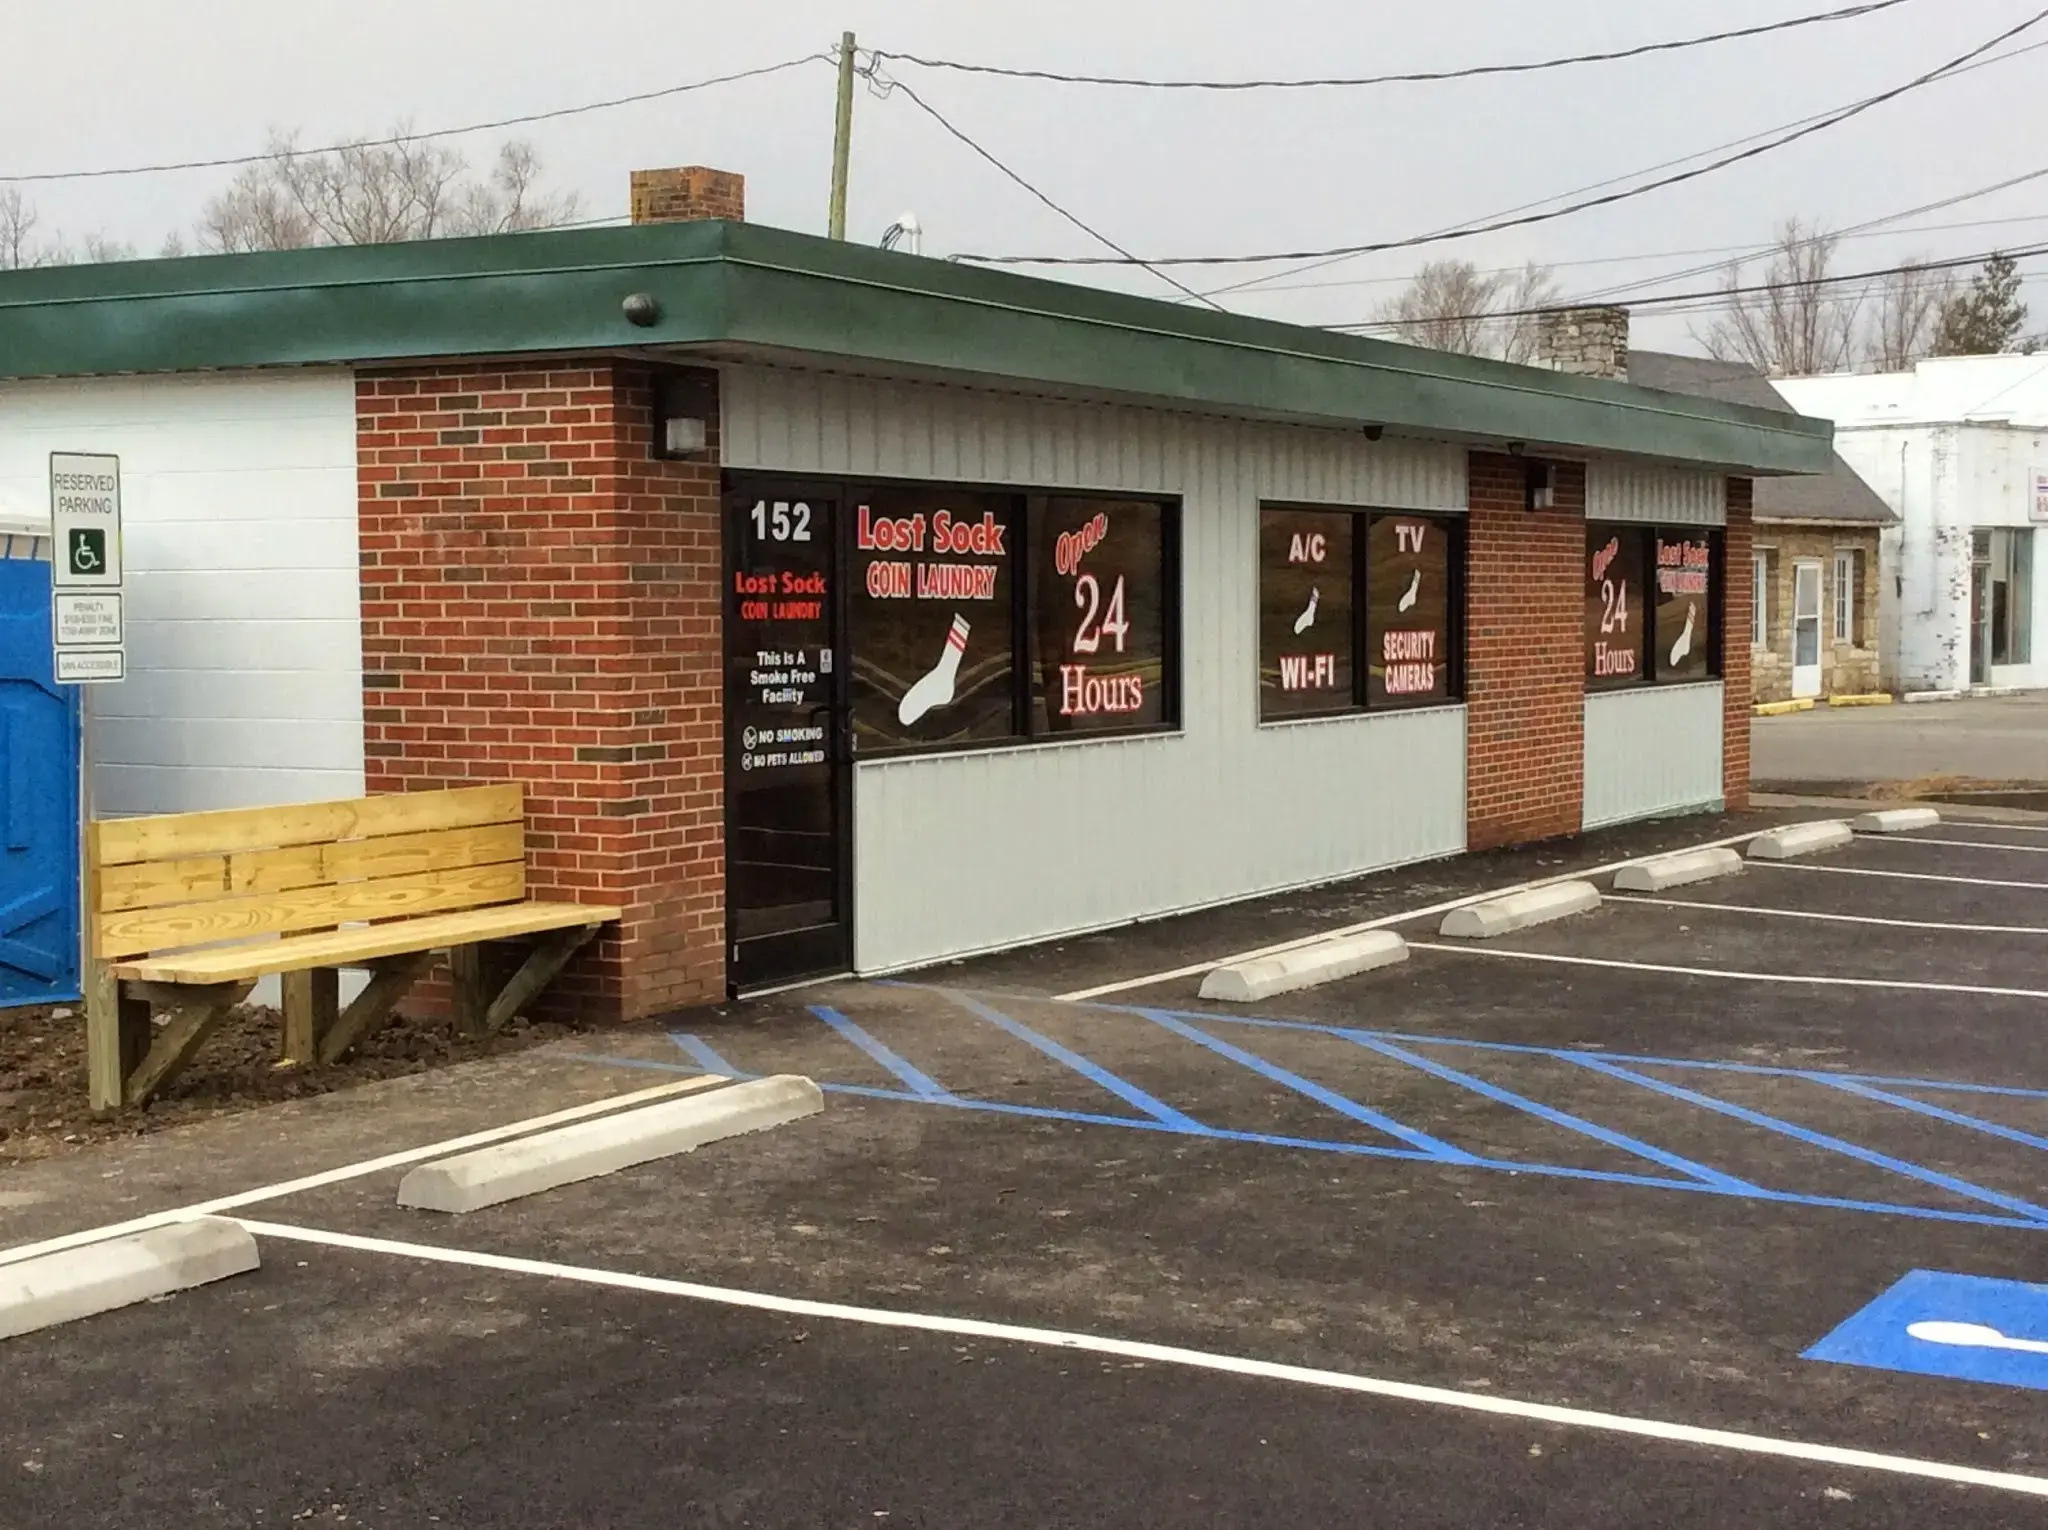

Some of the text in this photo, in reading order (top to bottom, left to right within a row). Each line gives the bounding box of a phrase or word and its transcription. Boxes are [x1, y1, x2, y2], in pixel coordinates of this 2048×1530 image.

[54, 473, 115, 492] RESERVED
[58, 497, 112, 514] PARKING
[751, 500, 811, 541] 152
[858, 505, 1006, 556] Lost Sock
[1055, 512, 1109, 576] Open
[1288, 533, 1326, 562] A/C
[1395, 524, 1426, 553] TV
[735, 571, 827, 594] Lost Sock
[866, 560, 998, 600] COIN LAUNDRY
[741, 601, 822, 620] COIN LAUNDRY
[1074, 574, 1130, 653] 24
[1601, 579, 1628, 634] 24
[757, 651, 781, 666] This
[796, 650, 806, 665] A
[1383, 631, 1436, 661] SECURITY
[1594, 642, 1635, 676] Hours
[750, 669, 816, 685] Smoke Free
[1280, 655, 1334, 690] WI-FI
[1384, 663, 1434, 694] CAMERAS
[762, 688, 804, 705] Facility
[1060, 664, 1143, 716] Hours
[759, 727, 823, 743] NO SMOKING
[753, 750, 825, 767] NO PETS ALLOWED
